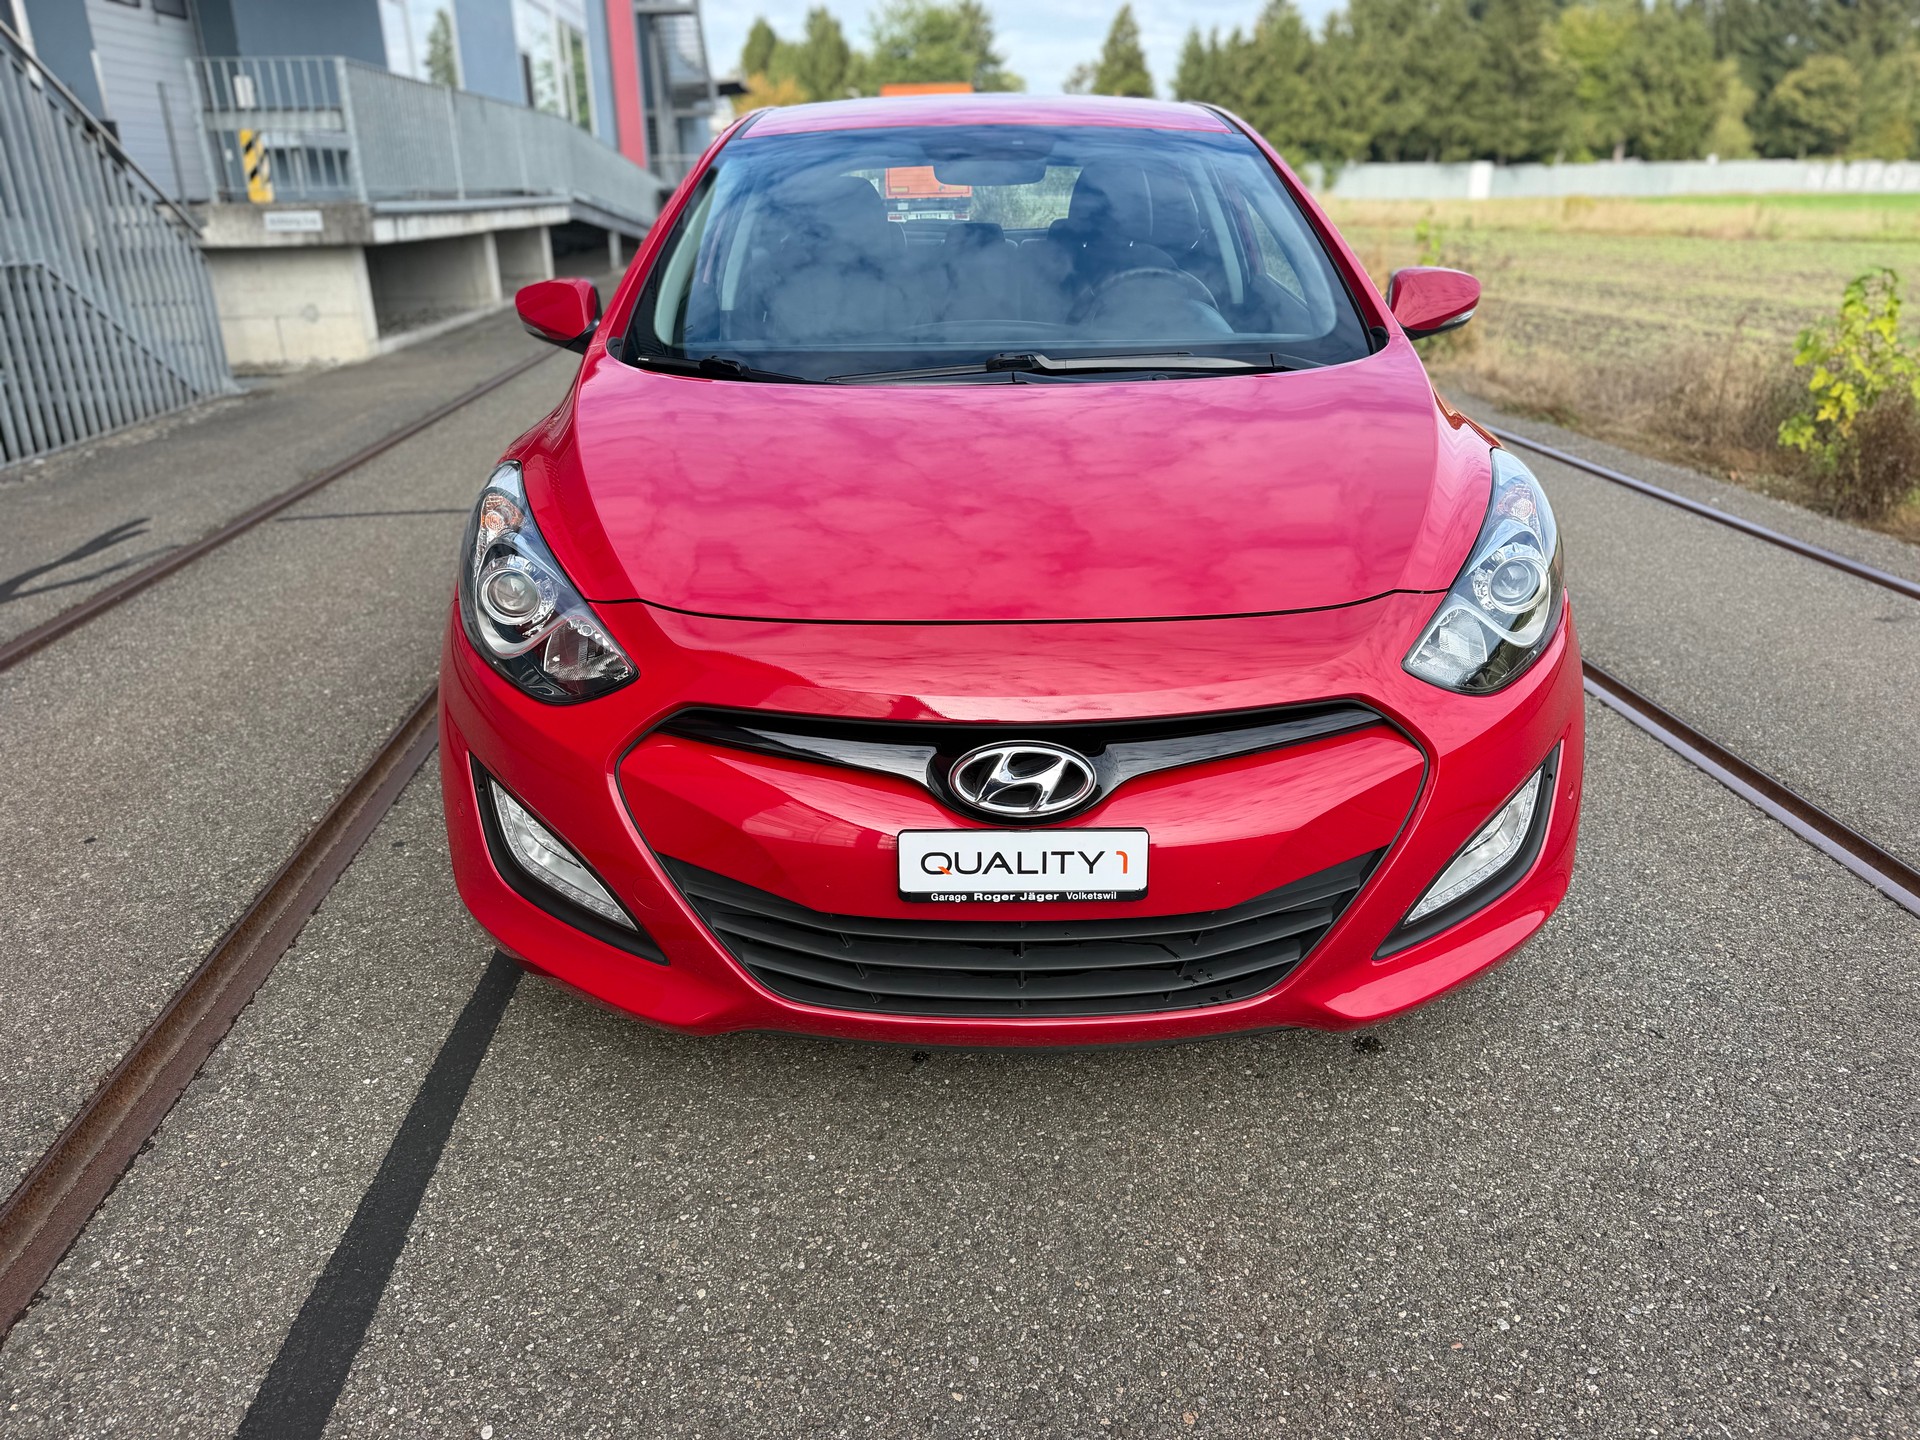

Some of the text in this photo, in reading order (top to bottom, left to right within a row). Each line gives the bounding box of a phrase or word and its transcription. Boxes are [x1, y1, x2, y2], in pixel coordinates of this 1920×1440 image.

[920, 850, 1128, 875] QUALITY 1
[930, 890, 1117, 903] Garage Roger Jäger Volketswil
